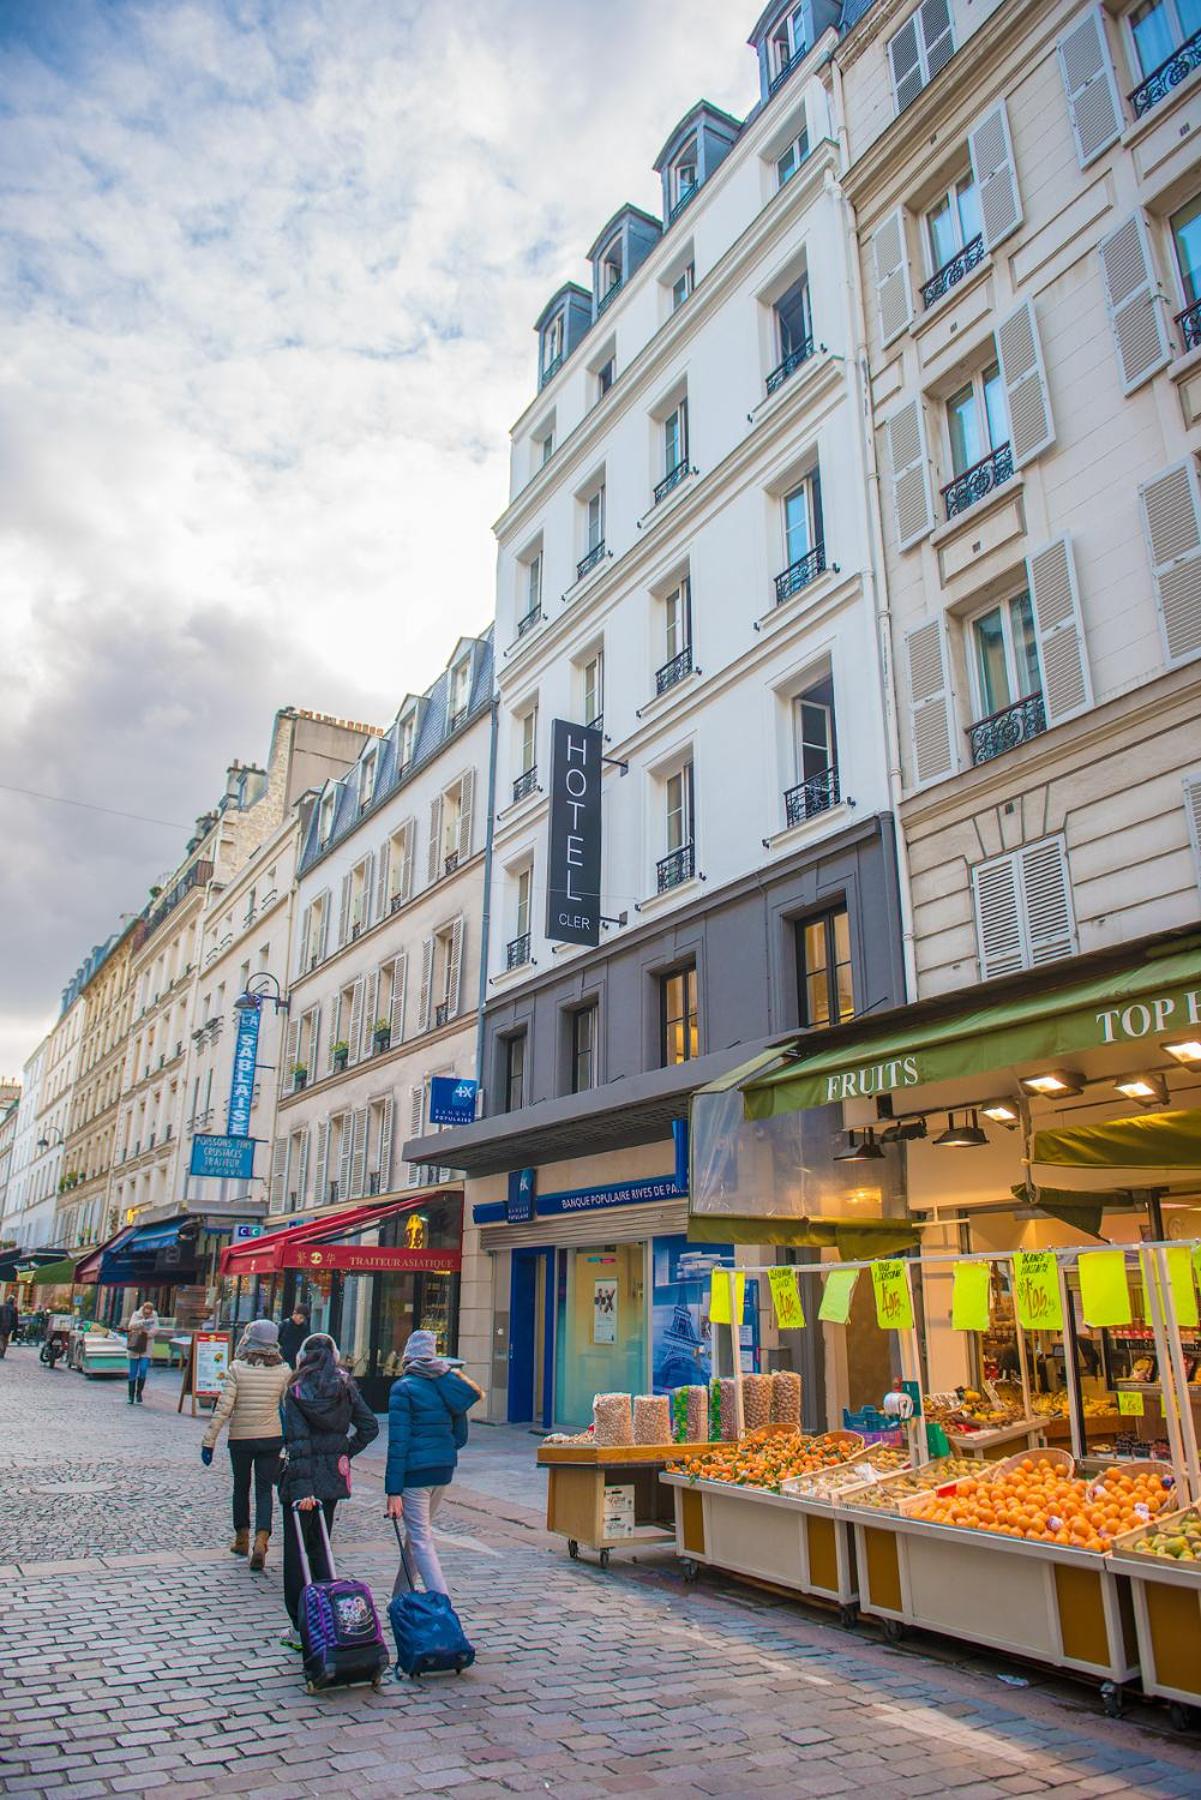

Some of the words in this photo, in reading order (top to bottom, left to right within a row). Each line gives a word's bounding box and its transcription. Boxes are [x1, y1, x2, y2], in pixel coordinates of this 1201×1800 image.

[565, 734, 587, 901] HOTEL
[558, 912, 590, 930] CLER
[241, 1014, 258, 1027] LA
[1095, 998, 1175, 1044] TOP
[231, 1034, 255, 1135] SABLAISE
[826, 1057, 918, 1101] FRUITS
[435, 1115, 471, 1123] POPULAIRE
[562, 1195, 590, 1209] BANQUE
[591, 1190, 631, 1205] POPULAIRE
[631, 1187, 653, 1200] RIVES
[654, 1184, 666, 1197] DE
[350, 1256, 400, 1267] TRAITEUR
[400, 1258, 454, 1269] ASIATIQUE
